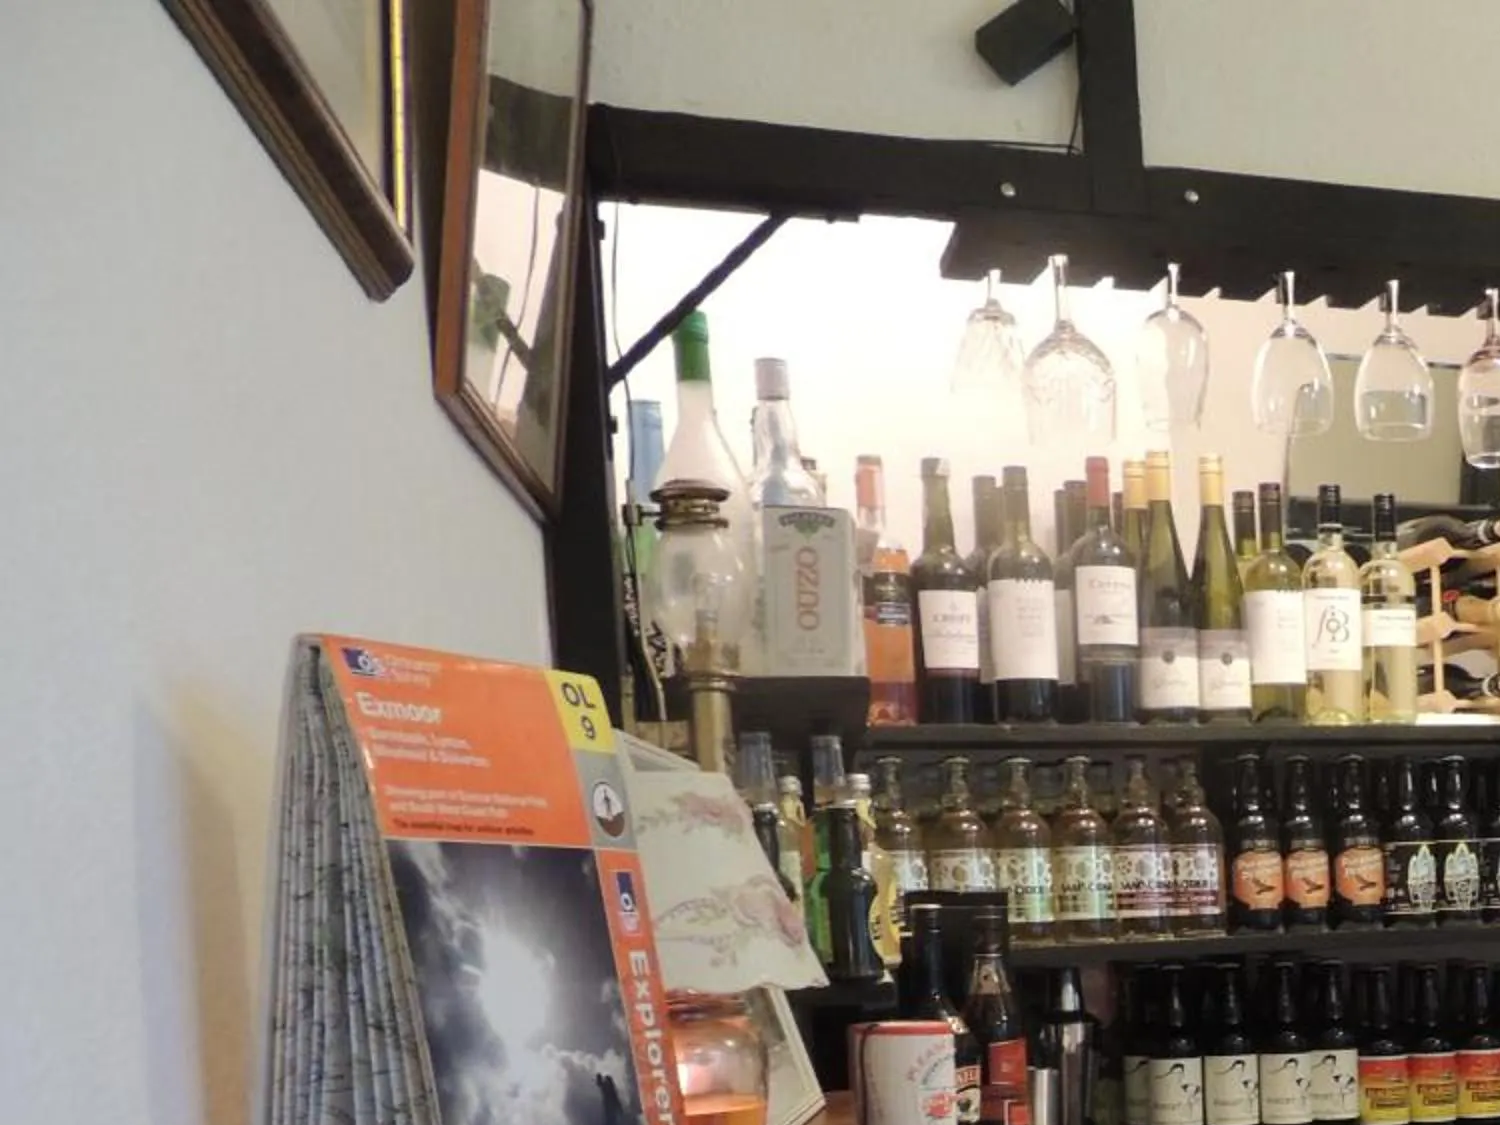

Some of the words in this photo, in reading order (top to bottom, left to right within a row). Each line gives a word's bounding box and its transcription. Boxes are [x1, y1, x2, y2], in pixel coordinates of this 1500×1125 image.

[794, 545, 821, 632] OUZO
[354, 691, 443, 724] Exmoor
[561, 681, 597, 711] OL
[579, 715, 597, 742] 9
